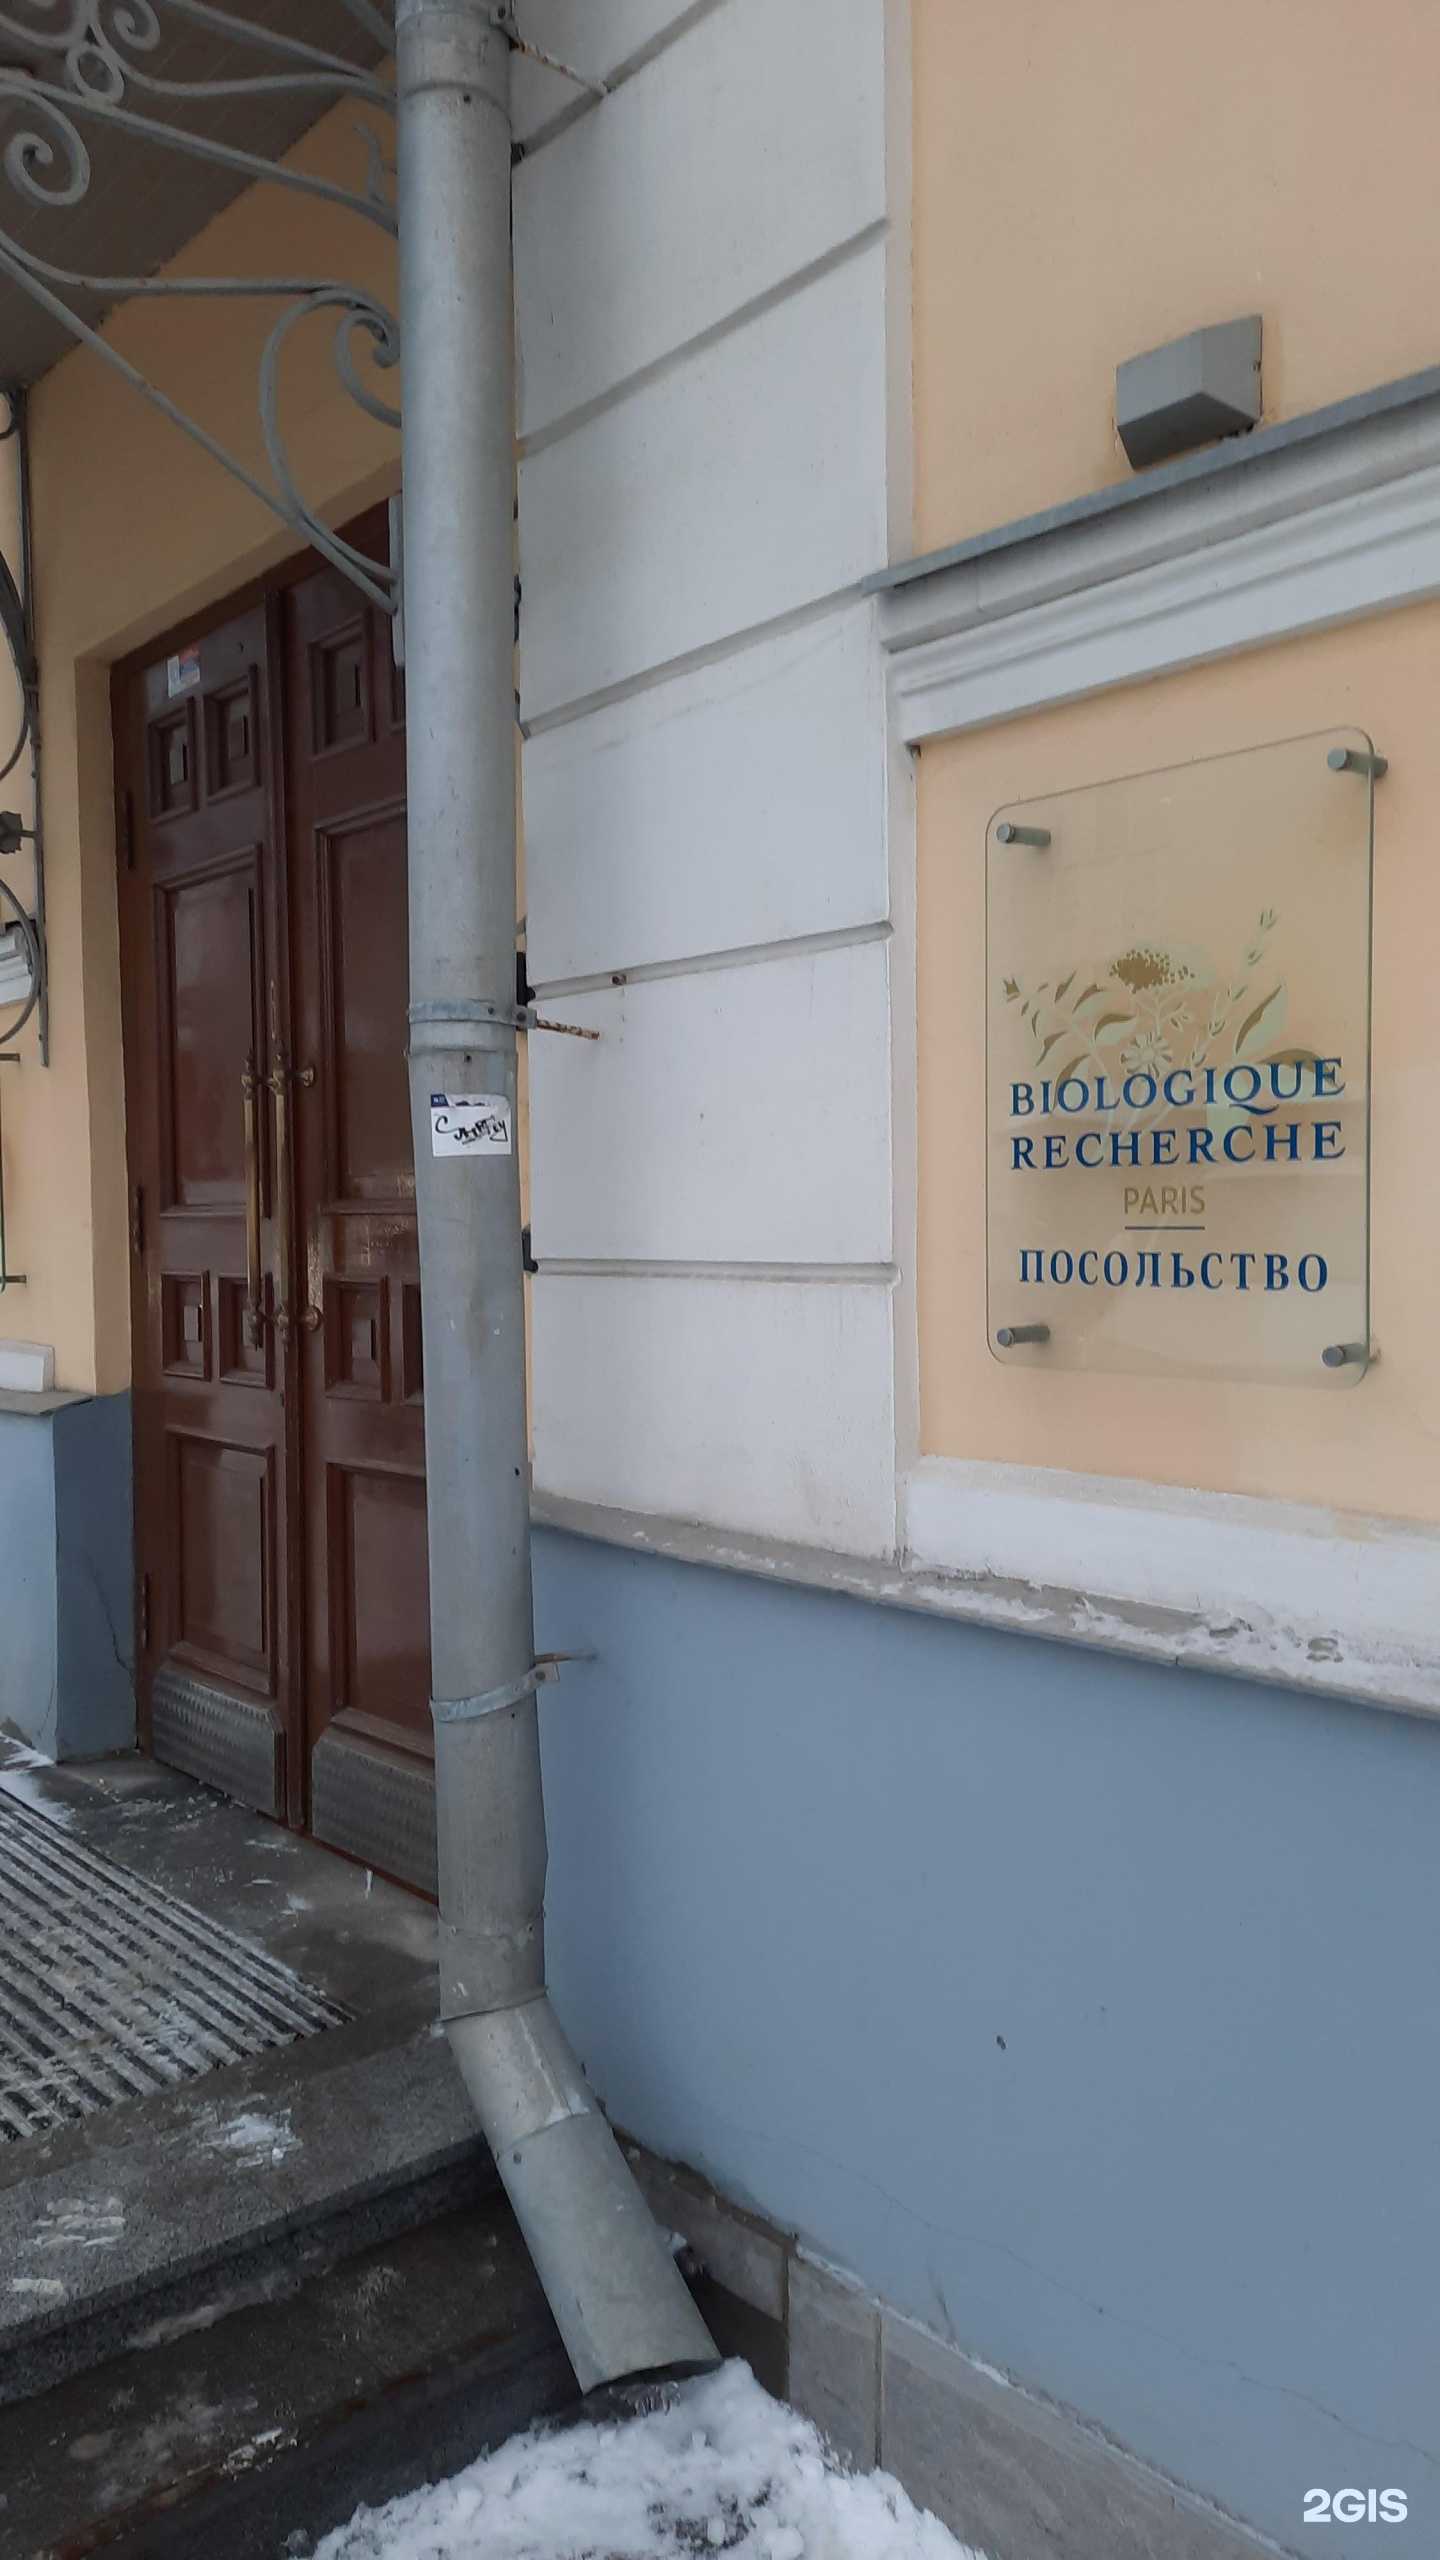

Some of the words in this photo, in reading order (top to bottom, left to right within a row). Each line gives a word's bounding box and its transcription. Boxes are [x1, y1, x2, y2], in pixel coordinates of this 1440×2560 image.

[1009, 1058, 1346, 1115] BIOLOGIQUE
[1010, 1122, 1346, 1169] RECHERCHE
[1124, 1186, 1206, 1215] PARIS
[1018, 1250, 1329, 1292] ПОСОЛЬСТВО
